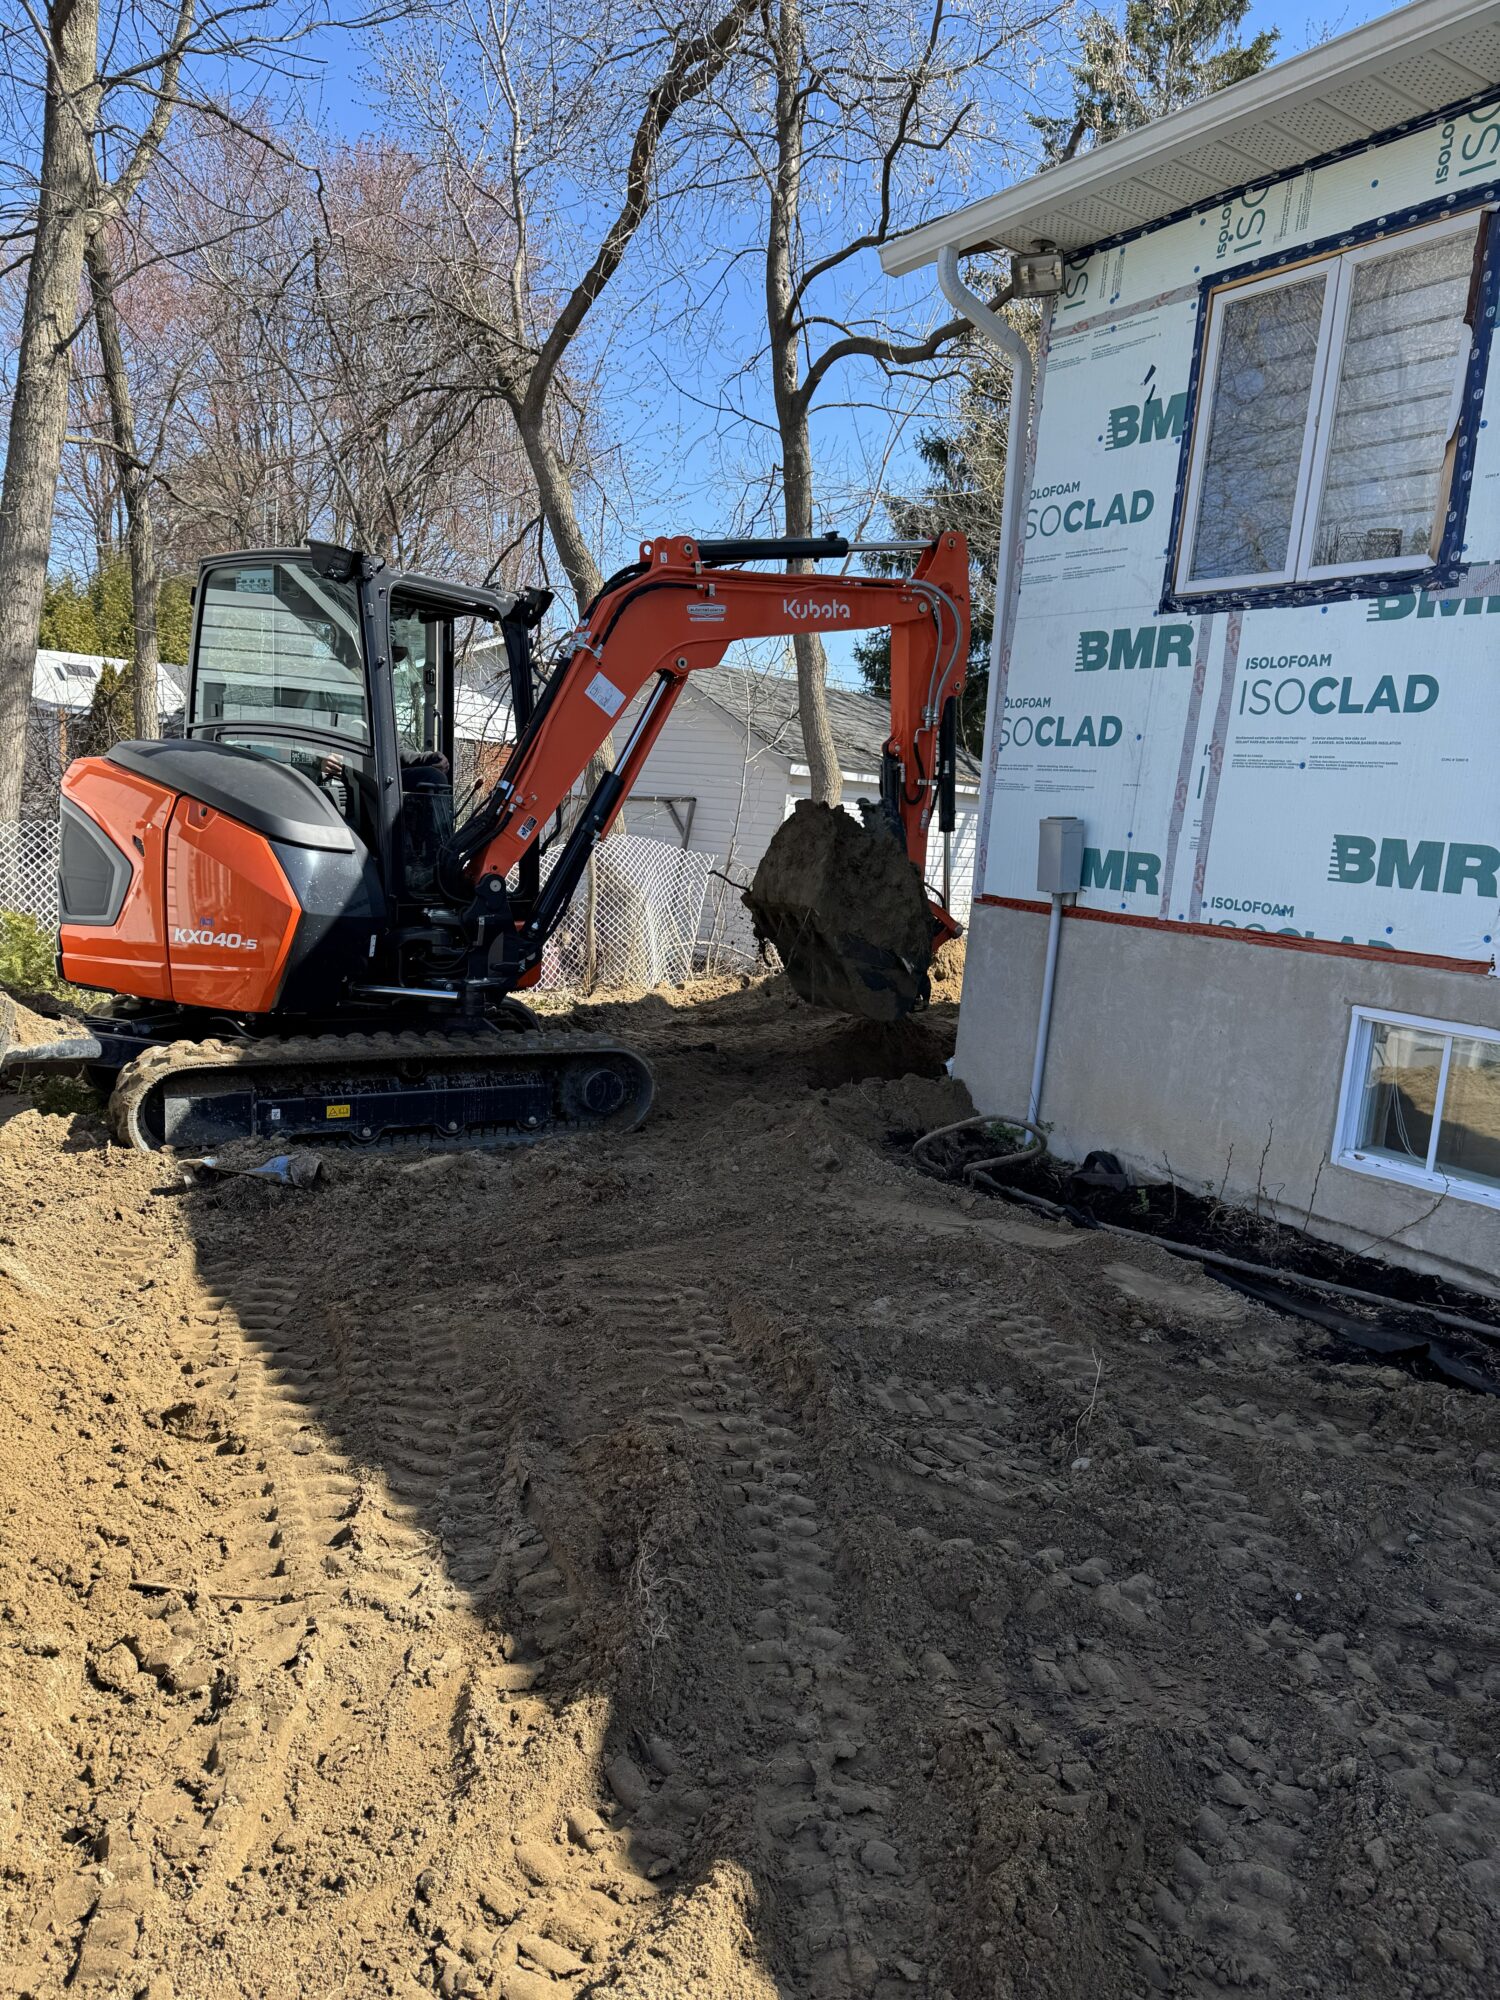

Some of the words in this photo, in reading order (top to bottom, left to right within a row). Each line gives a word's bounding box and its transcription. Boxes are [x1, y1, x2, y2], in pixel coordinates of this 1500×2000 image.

[1105, 391, 1188, 451] BM
[783, 598, 851, 619] Kubota
[1074, 623, 1195, 672] BMR
[1246, 653, 1333, 670] ISOLOFOAM
[1239, 674, 1440, 715] ISOCLAD
[1080, 847, 1162, 896] MR
[1327, 834, 1500, 898] BMR
[1210, 896, 1295, 919] ISOLOFOAM
[174, 928, 258, 950] KX040-5
